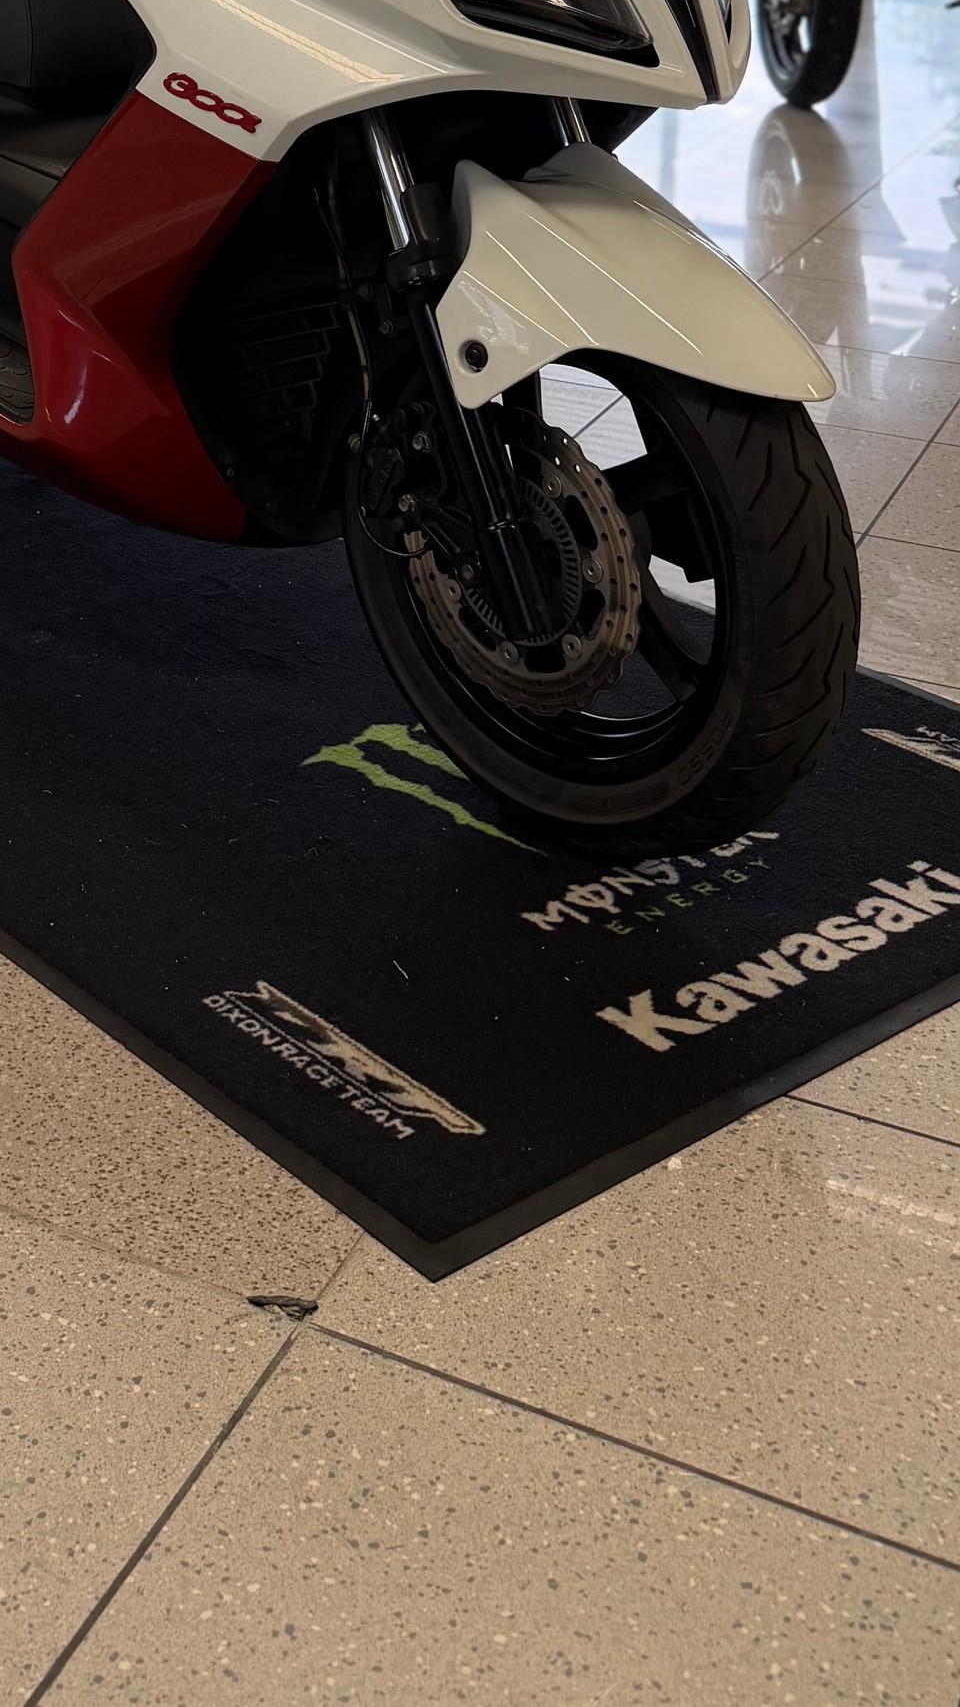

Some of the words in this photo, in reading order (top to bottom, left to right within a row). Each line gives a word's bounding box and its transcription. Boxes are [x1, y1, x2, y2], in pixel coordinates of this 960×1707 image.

[605, 857, 771, 936] ENERGY
[595, 859, 960, 1054] Kawasaki
[337, 1085, 416, 1141] TEAM
